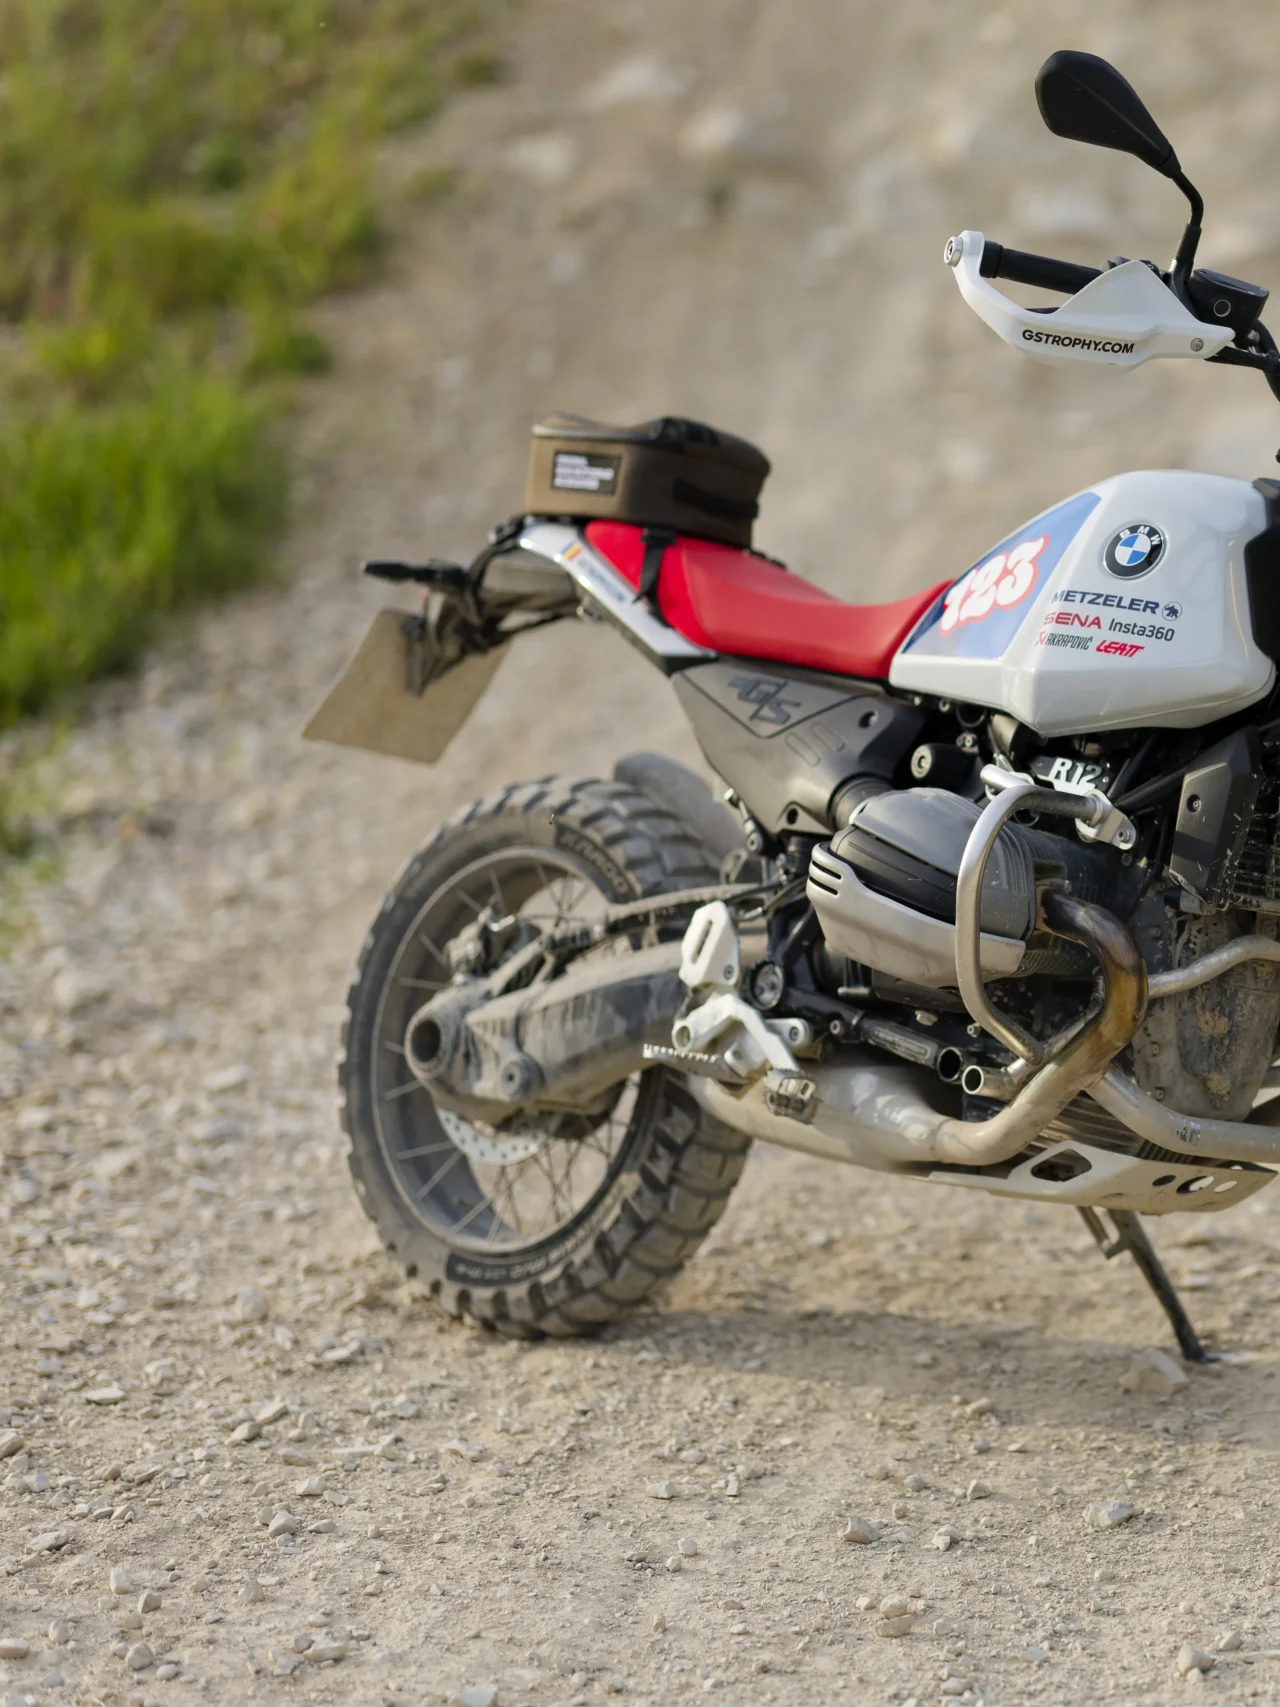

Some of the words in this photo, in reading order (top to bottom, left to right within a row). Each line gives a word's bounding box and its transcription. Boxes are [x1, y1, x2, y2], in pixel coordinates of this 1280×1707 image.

[1021, 329, 1135, 354] GSTROPHY.COM
[1119, 525, 1161, 546] BMW
[938, 533, 1051, 638] 123
[1051, 590, 1161, 615] METZELER
[1043, 611, 1102, 630] SENA
[1108, 618, 1176, 642] Insta360
[1095, 639, 1146, 658] LEATT
